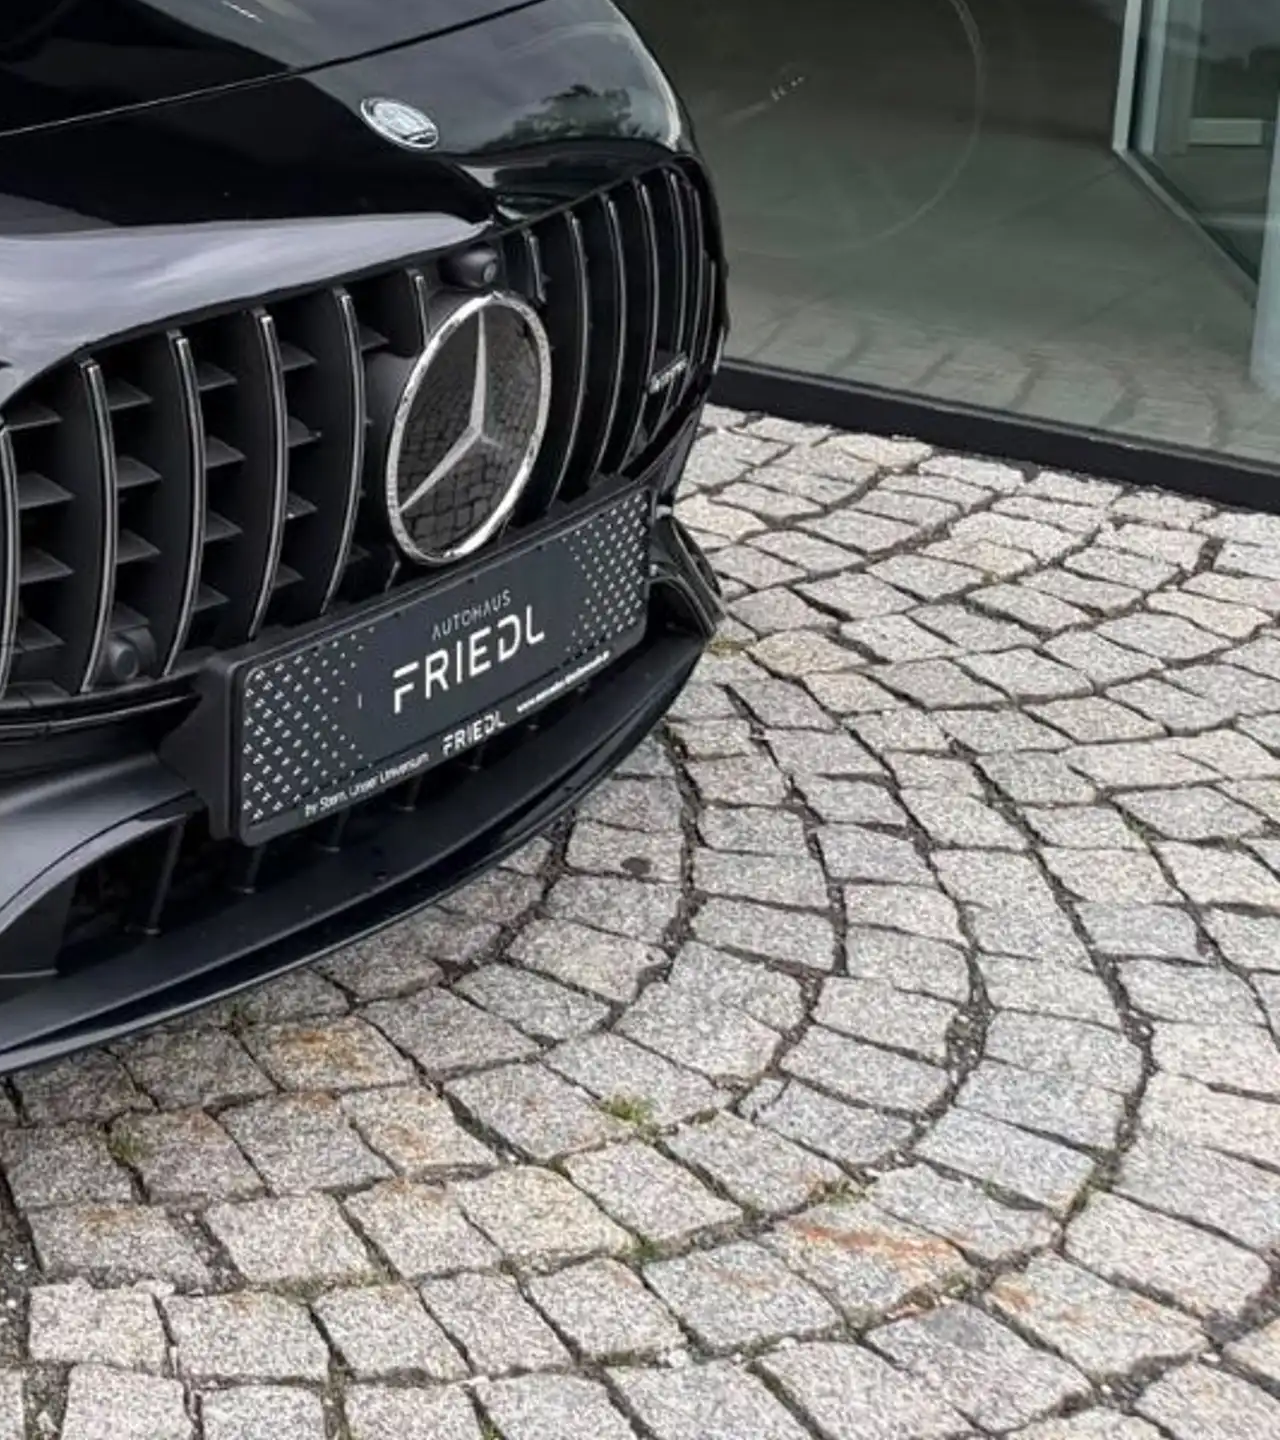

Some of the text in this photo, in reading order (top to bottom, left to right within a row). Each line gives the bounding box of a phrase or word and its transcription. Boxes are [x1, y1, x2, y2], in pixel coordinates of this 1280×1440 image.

[431, 588, 512, 641] AUTOHAUS
[392, 603, 546, 716] FRIEDL
[441, 710, 508, 758] FRIEDL
